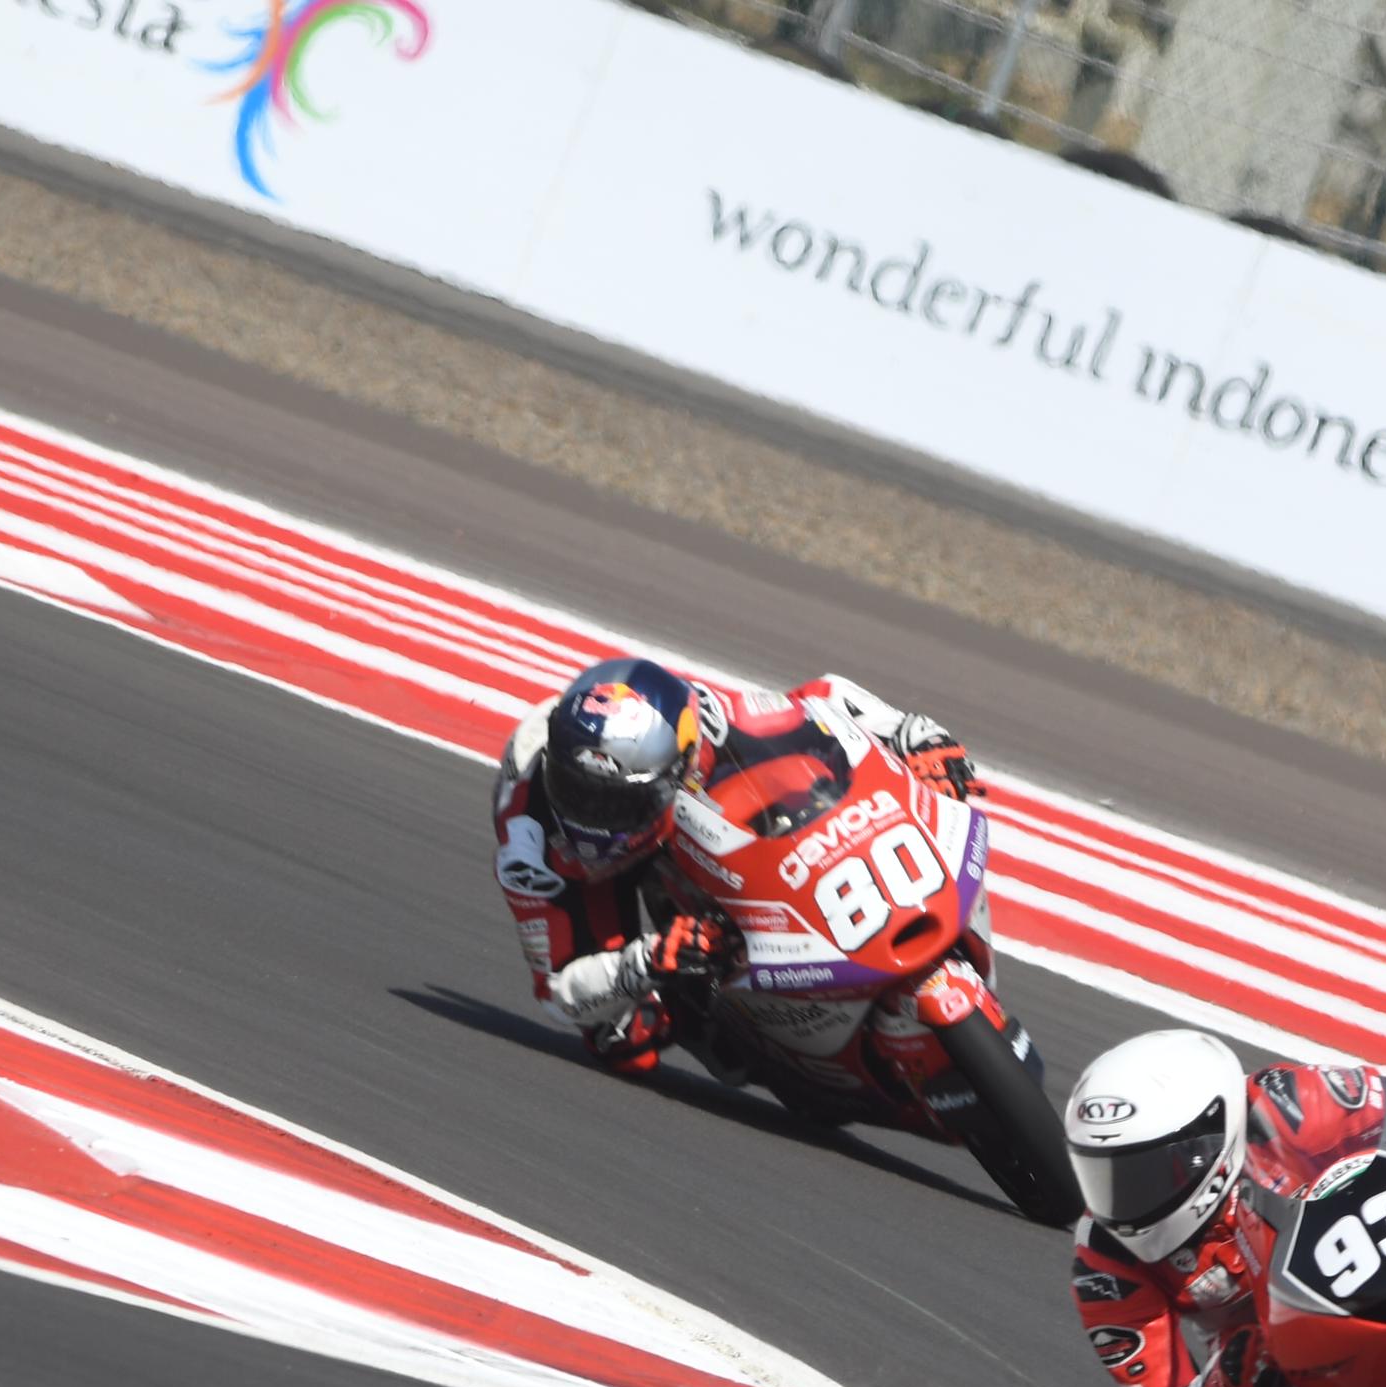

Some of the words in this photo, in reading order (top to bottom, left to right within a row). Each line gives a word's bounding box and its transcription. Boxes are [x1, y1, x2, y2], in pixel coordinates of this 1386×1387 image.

[707, 188, 1121, 382] wonderful
[814, 822, 947, 952] 80
[1085, 1101, 1127, 1119] KYT
